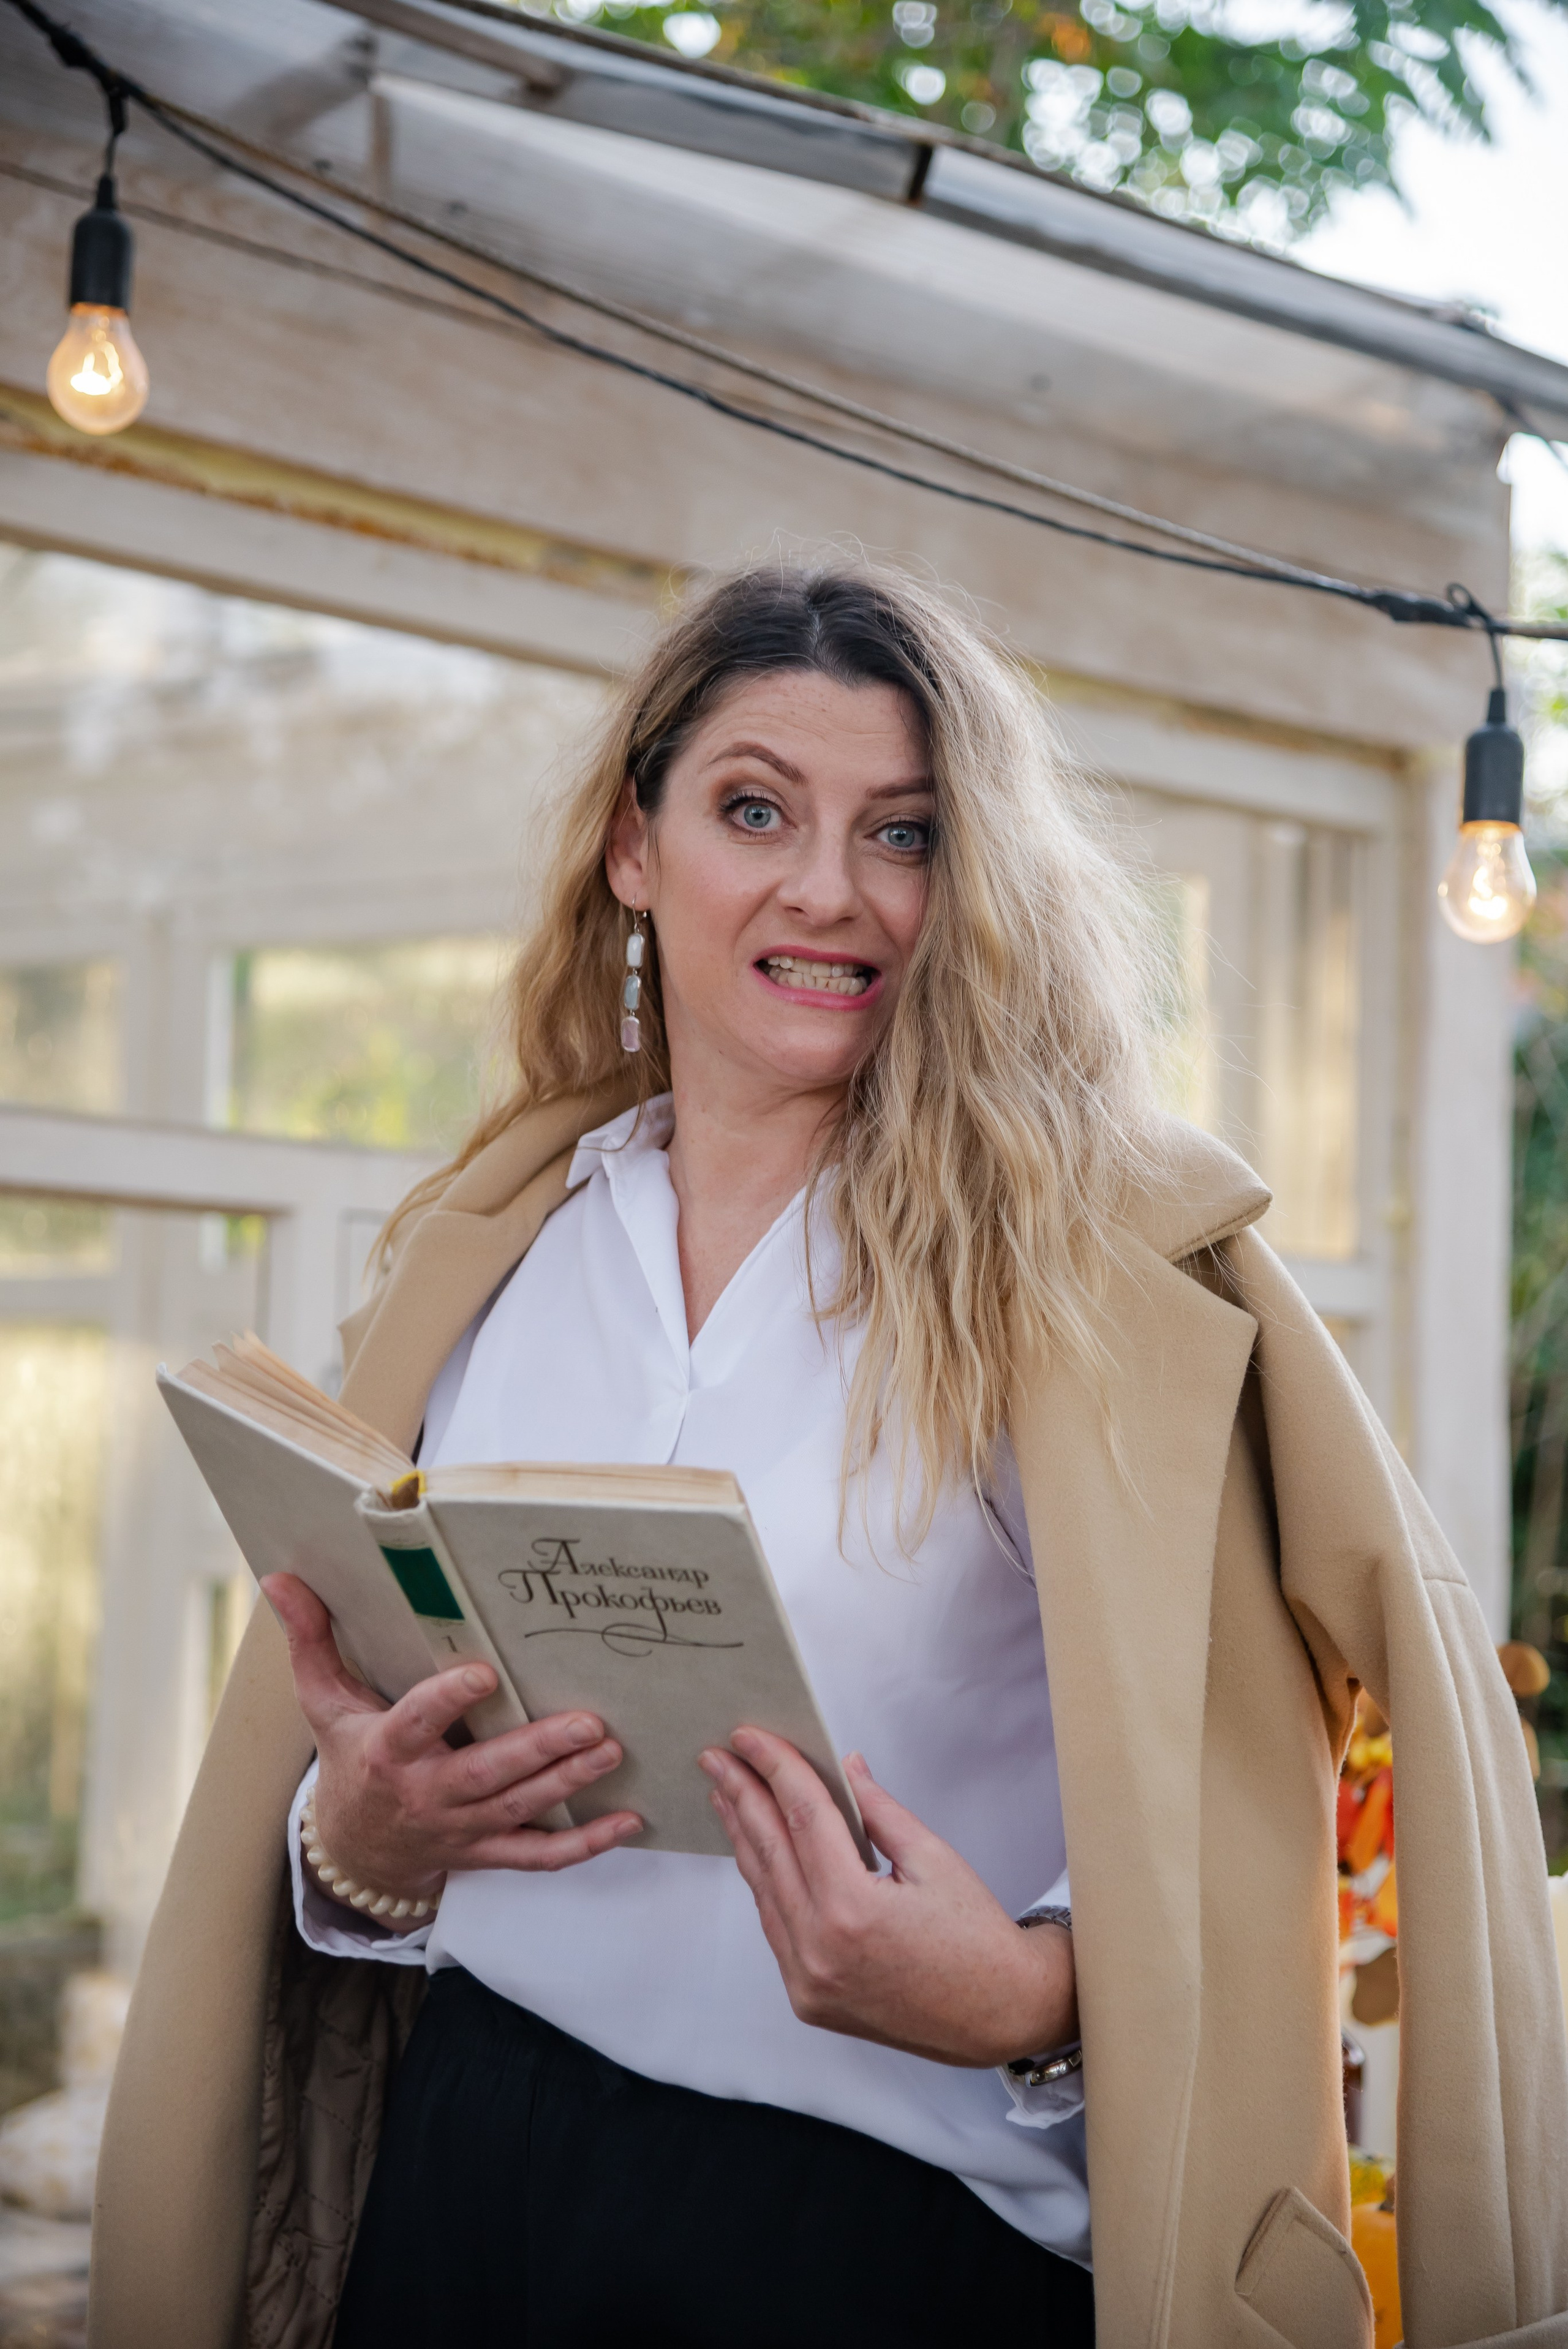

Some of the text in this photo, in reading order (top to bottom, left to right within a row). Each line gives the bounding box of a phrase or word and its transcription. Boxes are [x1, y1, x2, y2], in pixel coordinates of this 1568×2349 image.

[528, 1537, 709, 1589] Александр
[498, 1569, 722, 1643] Прокофьев
[441, 1635, 458, 1653] 1
